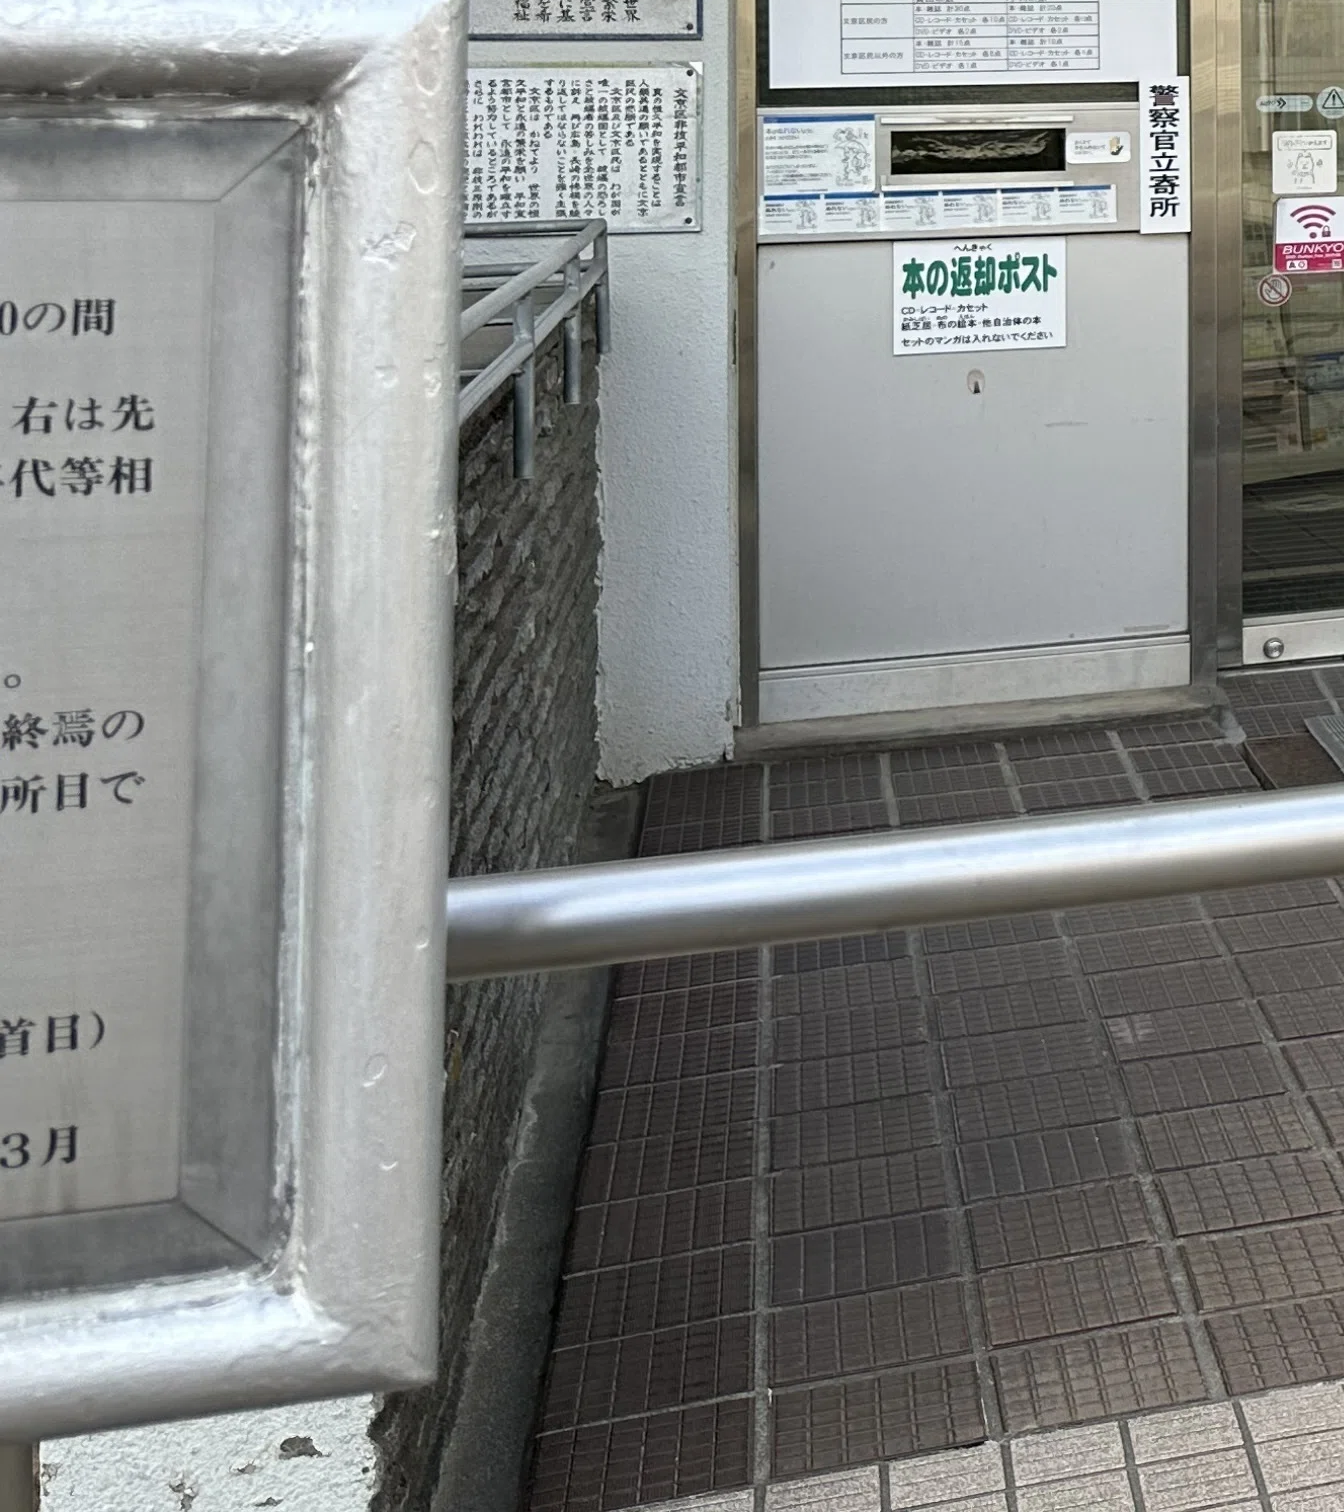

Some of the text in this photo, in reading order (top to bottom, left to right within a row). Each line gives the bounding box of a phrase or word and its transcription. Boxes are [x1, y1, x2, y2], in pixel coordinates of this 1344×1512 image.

[543, 78, 555, 139] するものである
[673, 88, 688, 207] 文京区非核平和都市宣言
[1148, 84, 1181, 218] 警察官立寄所
[954, 244, 993, 252] へんきゃく
[1282, 243, 1344, 255] BUNKYO
[902, 252, 1058, 300] 本の返却ポスト
[901, 331, 1054, 347] セットのマンガは入れないでください
[11, 394, 157, 435] 右は先
[0, 455, 153, 498] 代等相
[0, 707, 145, 751] 終焉の
[0, 770, 147, 815] 所目で
[0, 1124, 79, 1169] 3月
